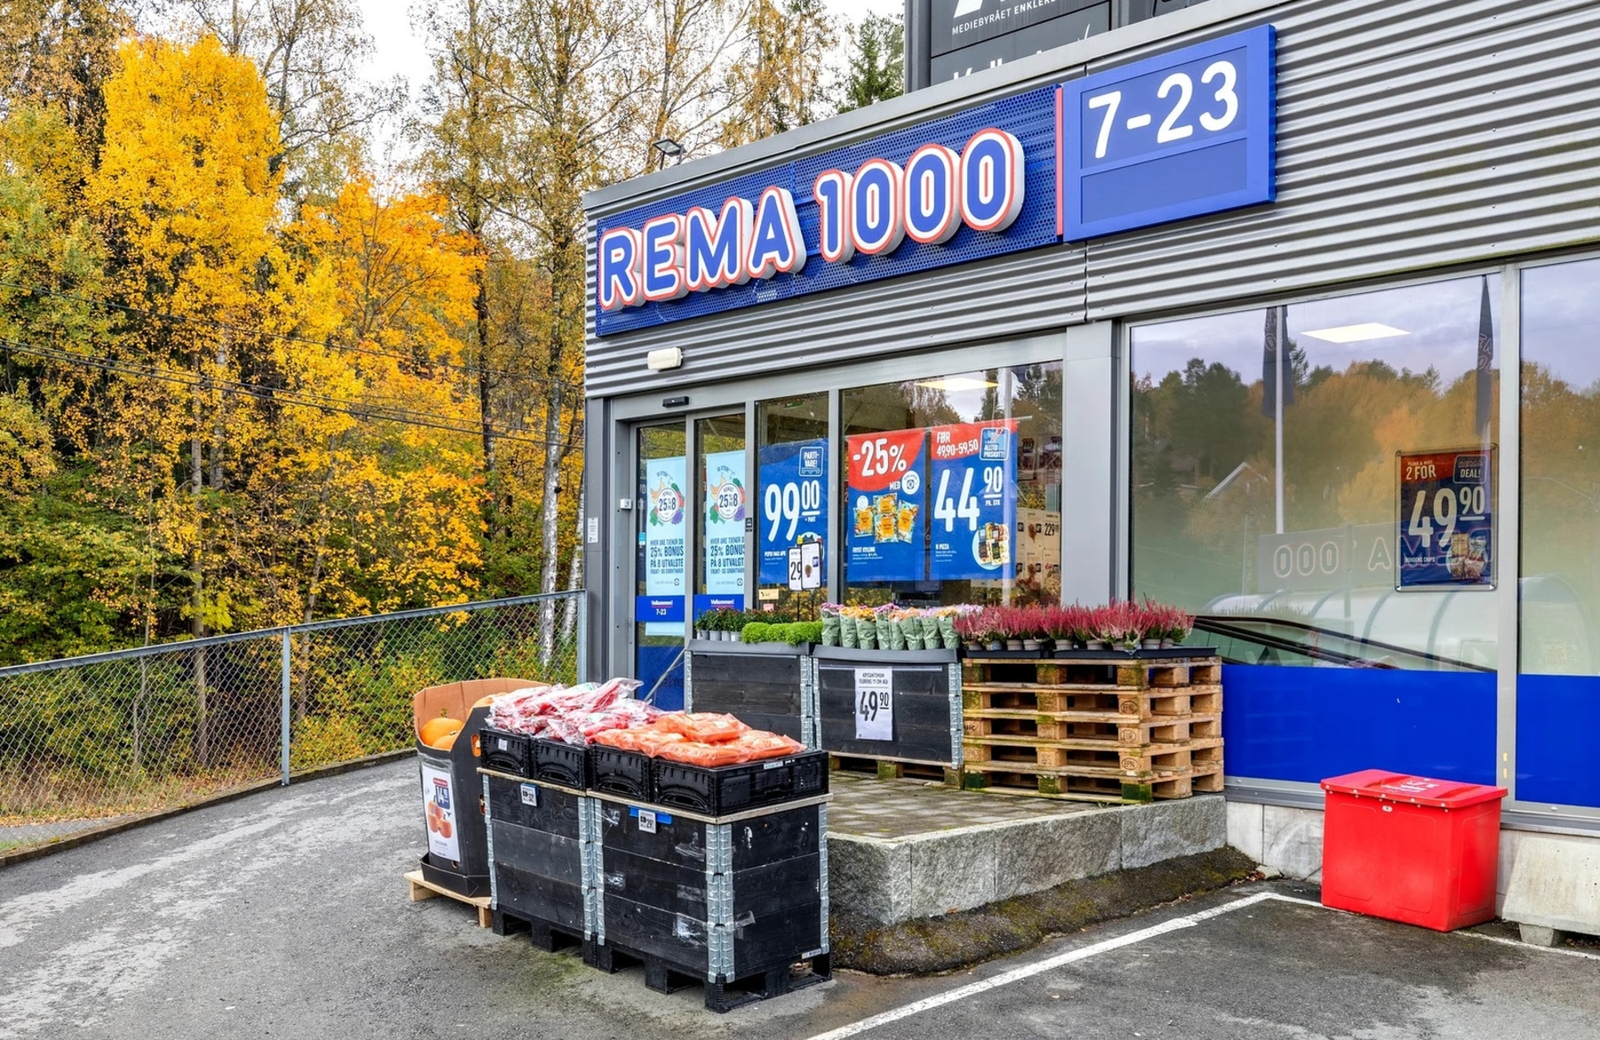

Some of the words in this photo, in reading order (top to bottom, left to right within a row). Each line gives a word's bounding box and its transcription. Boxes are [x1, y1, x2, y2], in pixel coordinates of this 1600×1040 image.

[952, 8, 1011, 35] MEDIEBYRÅET
[1014, 0, 1056, 15] ENKLER
[1088, 60, 1239, 159] 7-23
[600, 186, 803, 310] REMA
[814, 128, 1020, 263] 1000
[937, 431, 951, 443] FØR
[936, 439, 979, 458] 49,90-59,50
[853, 437, 907, 477] -25%
[1406, 467, 1413, 480] 2
[1414, 465, 1437, 480] FOR
[1460, 469, 1481, 478] DEAL!
[889, 480, 901, 490] MED
[659, 498, 667, 511] 25
[672, 497, 676, 510] 8
[719, 494, 729, 508] 25
[733, 493, 738, 507] 8
[934, 467, 980, 532] 44
[983, 466, 1003, 493] 90
[764, 482, 800, 542] 99
[801, 480, 820, 509] 00
[1408, 488, 1457, 547] 49
[1459, 486, 1485, 515] 90
[1044, 523, 1055, 536] 229
[650, 547, 663, 557] 25%
[664, 545, 684, 557] BONUS
[710, 545, 724, 556] 25%
[650, 557, 657, 568] PÅ
[662, 558, 684, 567] UTVALGTE
[710, 557, 717, 568] PÅ
[718, 558, 722, 568] 8
[722, 557, 745, 567] UTVALGT
[790, 562, 801, 580] 29
[859, 690, 878, 722] 49
[879, 692, 889, 707] 90
